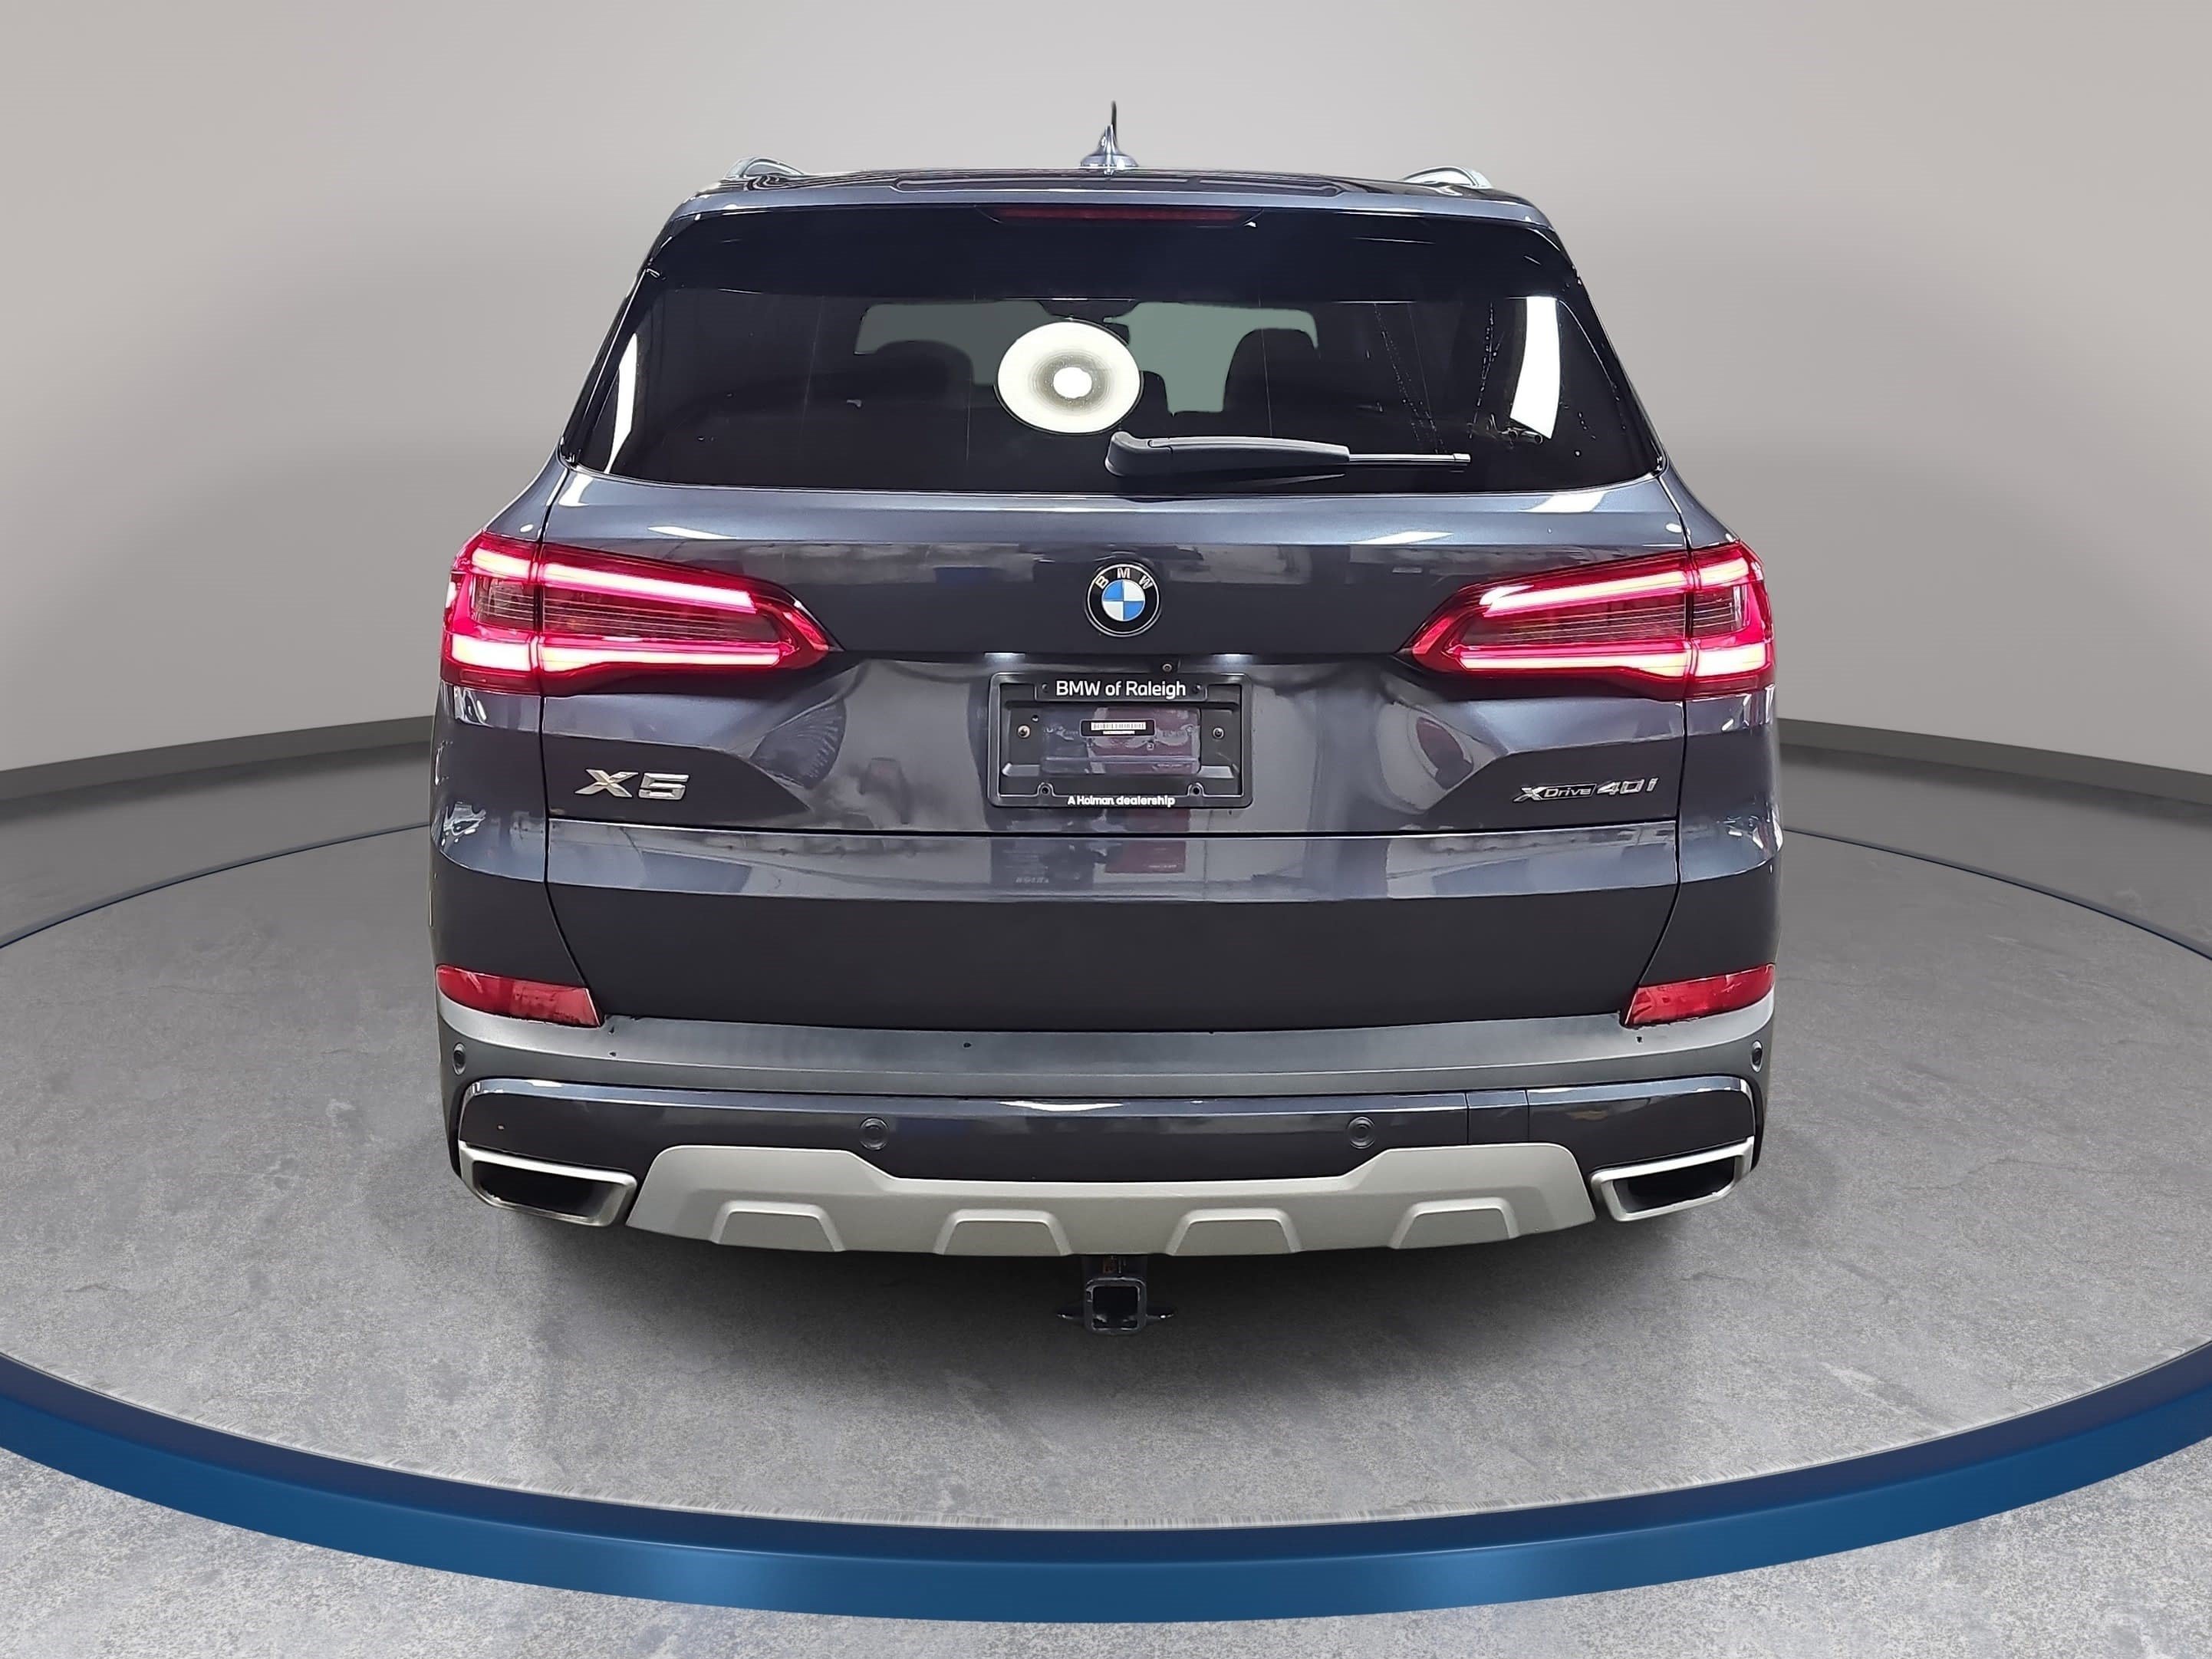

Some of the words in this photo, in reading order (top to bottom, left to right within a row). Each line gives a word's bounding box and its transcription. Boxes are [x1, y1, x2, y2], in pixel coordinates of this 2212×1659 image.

[1094, 567, 1154, 590] BMW
[1055, 680, 1101, 696] BMW
[1104, 680, 1122, 696] of
[1125, 680, 1187, 699] Raleigh
[574, 769, 690, 801] X5
[1067, 795, 1075, 805] A
[1076, 795, 1115, 805] Holman
[1115, 795, 1176, 808] dealership
